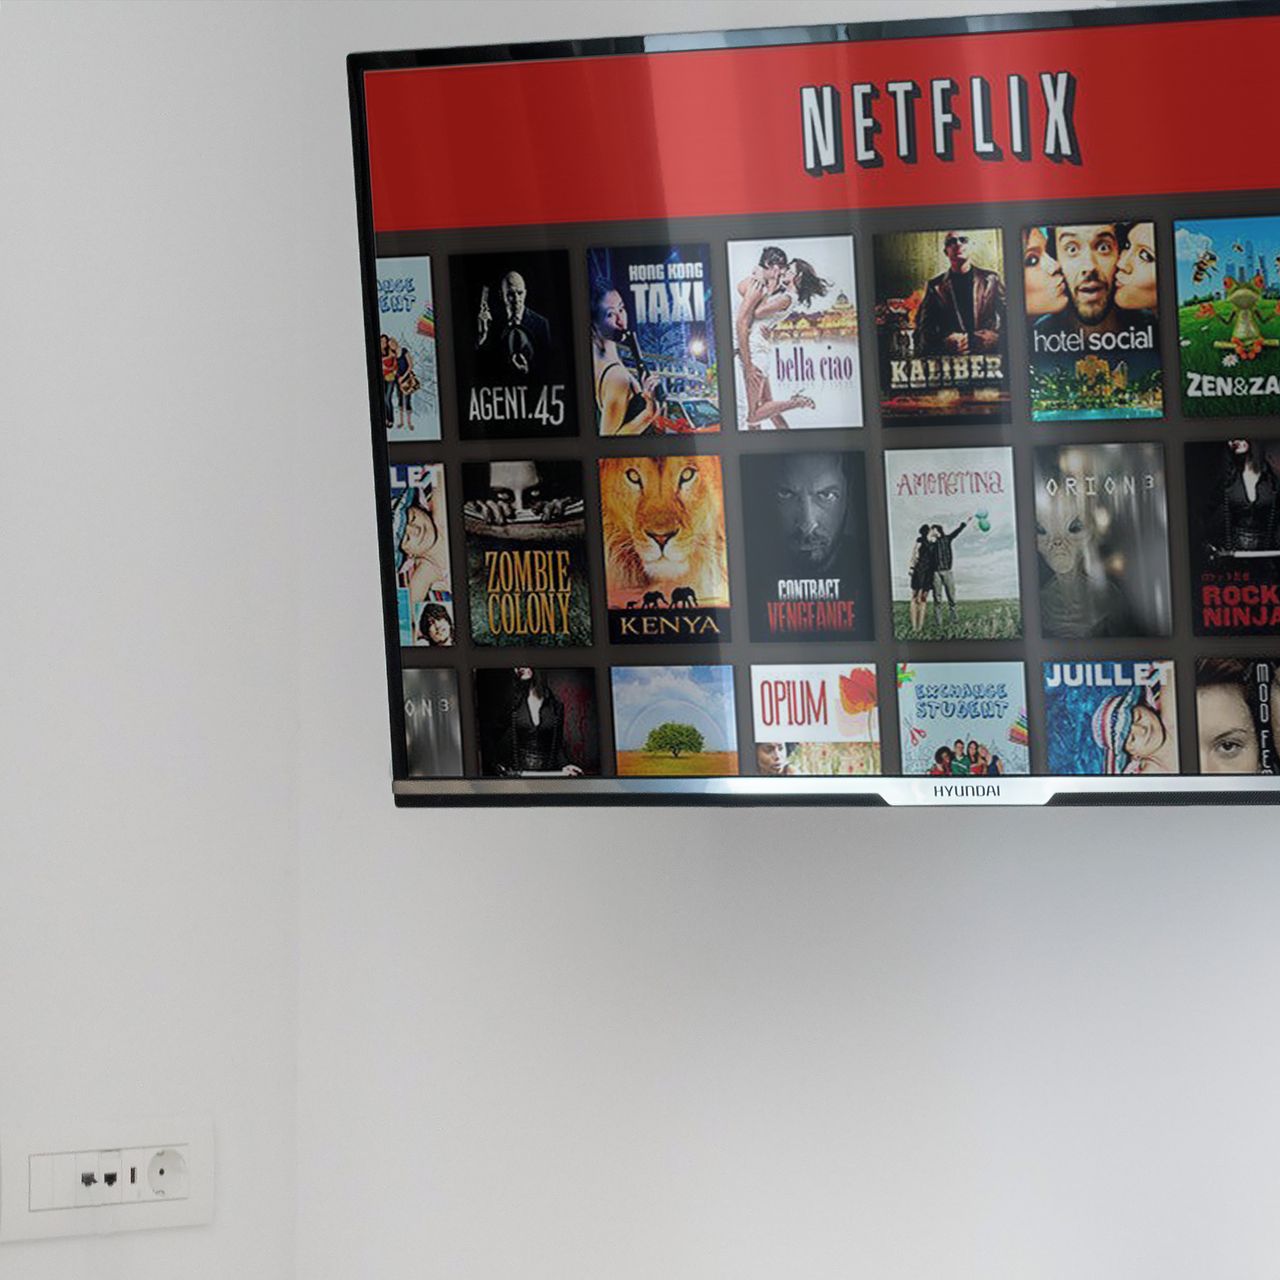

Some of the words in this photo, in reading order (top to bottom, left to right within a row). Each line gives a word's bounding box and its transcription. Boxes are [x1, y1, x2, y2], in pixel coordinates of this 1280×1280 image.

[800, 71, 1082, 177] NETFLIX
[667, 262, 703, 279] KONG
[630, 281, 705, 323] TAXI
[1033, 328, 1084, 352] hotel
[1088, 325, 1153, 350] social
[775, 347, 815, 382] bella
[820, 345, 853, 380] ciao
[889, 355, 1004, 384] KALIBER
[469, 385, 565, 425] AGENT.45
[1046, 476, 1135, 496] ORION
[485, 550, 571, 593] ZOMBIE
[778, 578, 840, 600] CONTRACT
[488, 592, 571, 635] COLONY
[620, 616, 720, 635] KENYA
[767, 600, 856, 634] VENGEANCE
[1045, 661, 1170, 687] JUILLET
[760, 680, 828, 726] OPIUM
[916, 701, 1008, 719] STUDENT
[933, 785, 1001, 797] HYUNDAI
